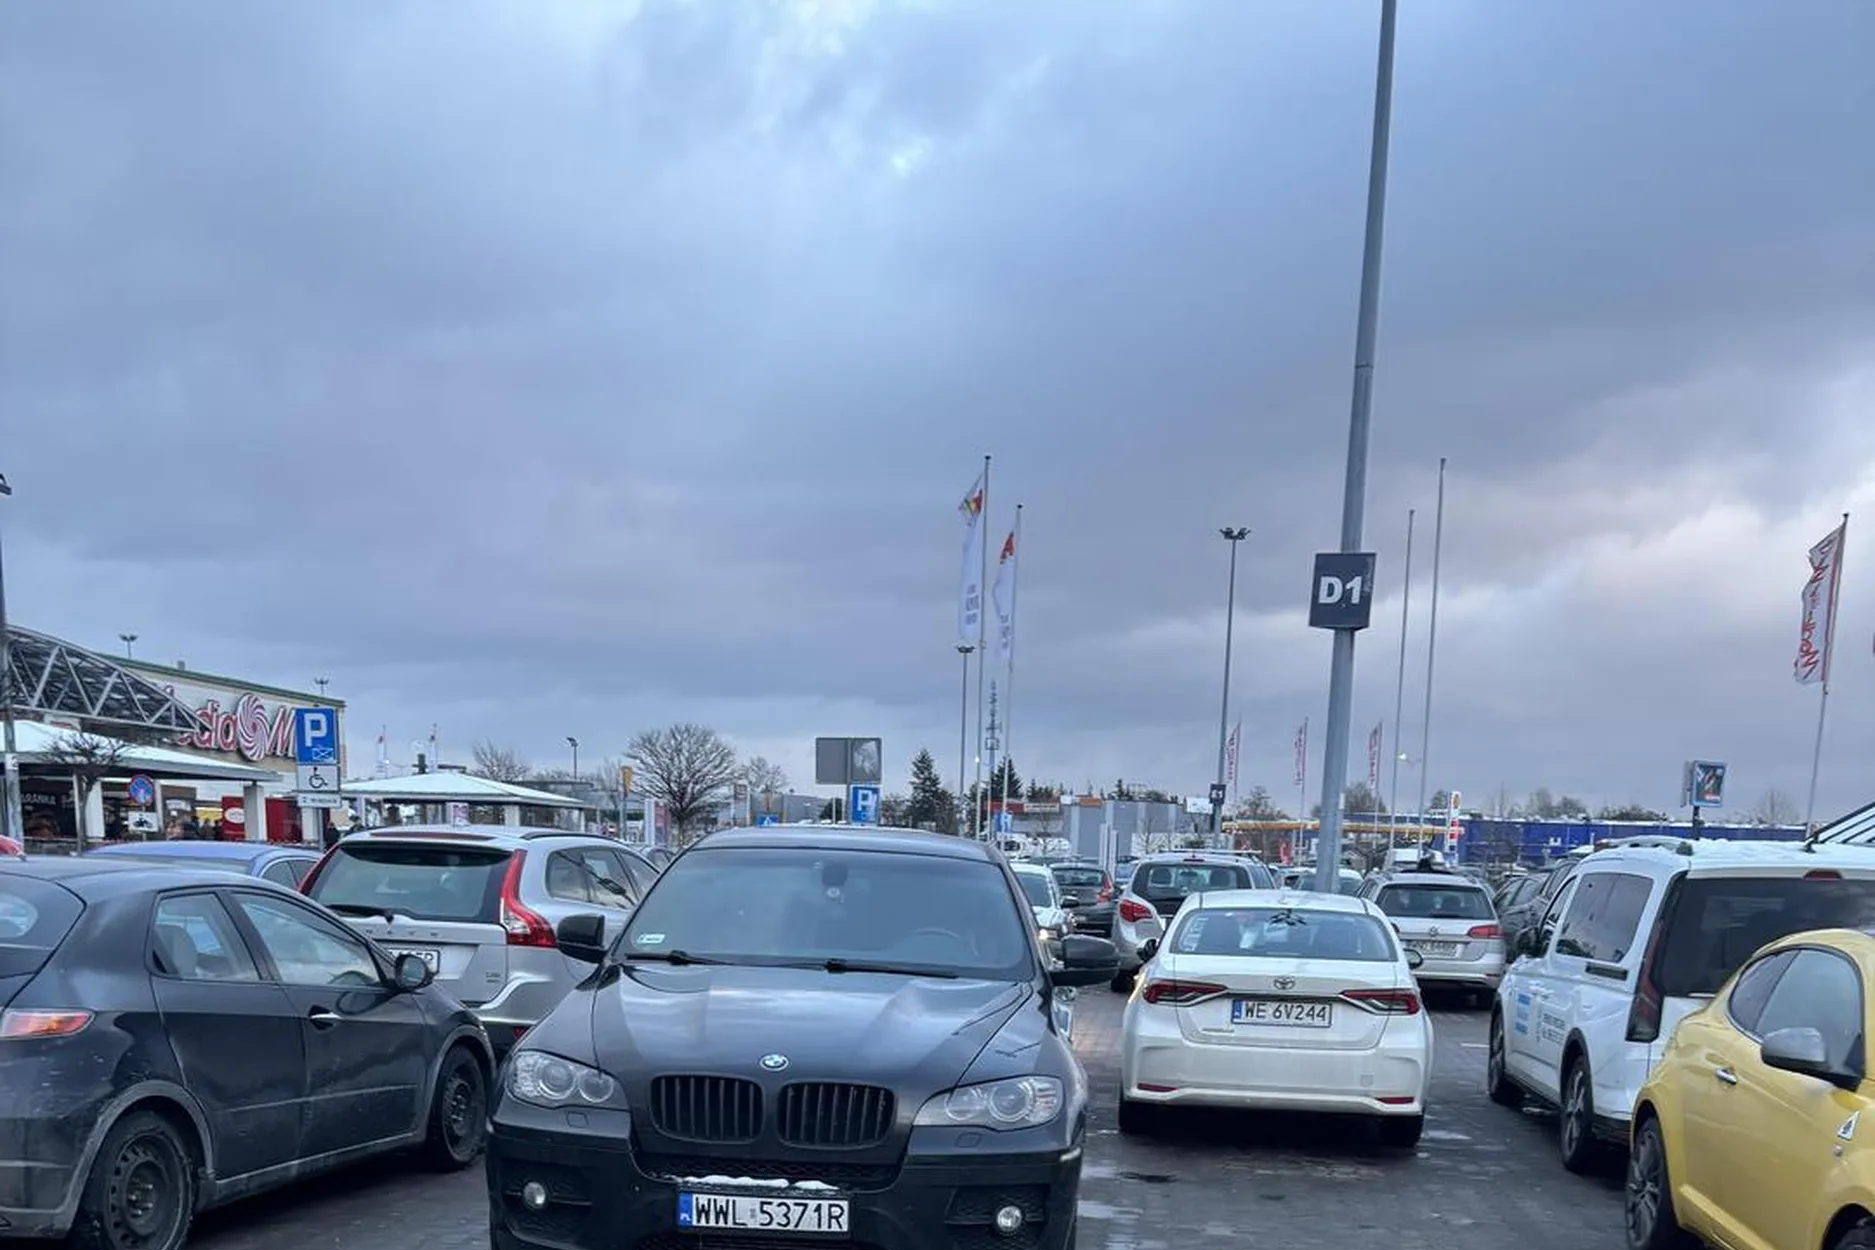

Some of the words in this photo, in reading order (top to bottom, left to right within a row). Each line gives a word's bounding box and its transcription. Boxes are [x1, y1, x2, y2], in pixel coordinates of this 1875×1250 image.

[1319, 576, 1362, 604] D1
[304, 714, 328, 747] P
[1245, 1001, 1266, 1019] WE
[1273, 1004, 1326, 1021] 6V244
[695, 1197, 748, 1227] WWL
[759, 1201, 845, 1230] 5371R
